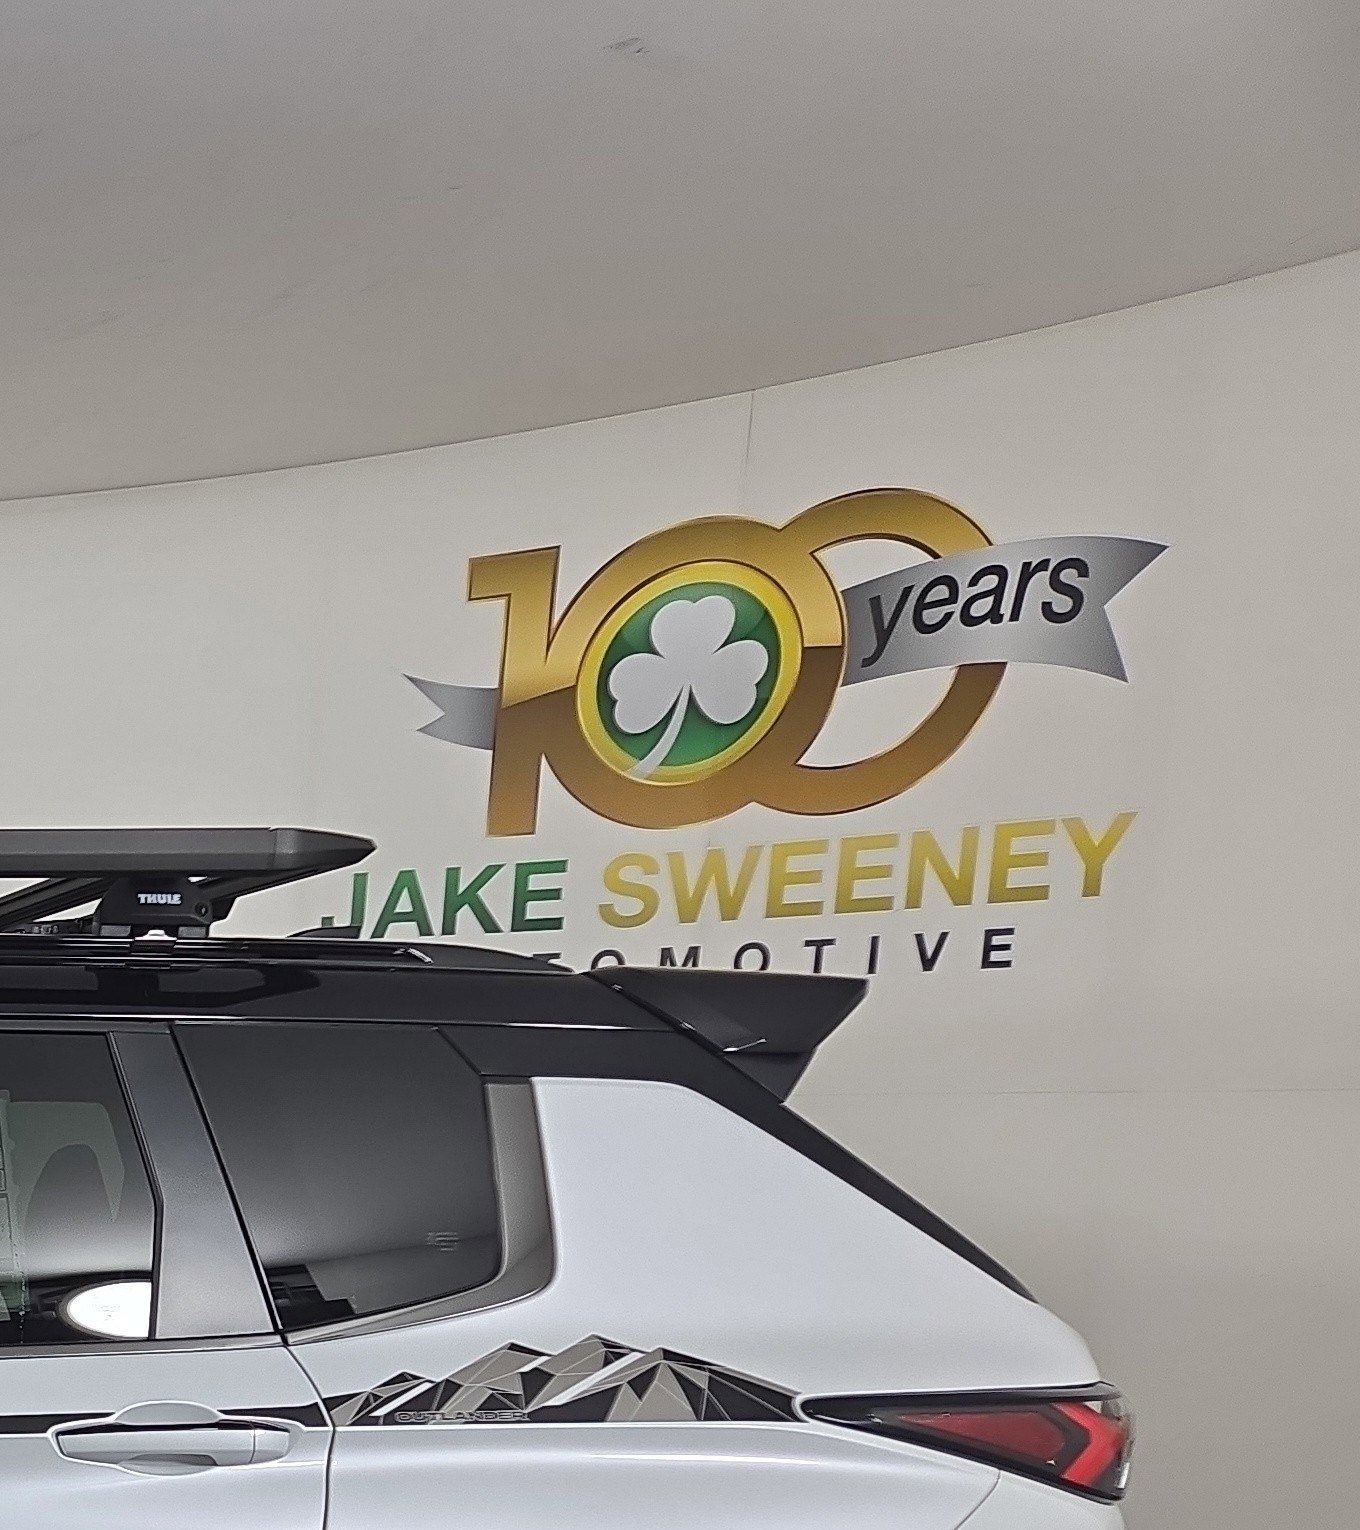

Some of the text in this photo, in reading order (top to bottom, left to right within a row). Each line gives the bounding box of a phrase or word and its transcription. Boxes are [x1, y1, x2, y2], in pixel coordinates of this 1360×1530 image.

[861, 555, 1089, 667] years
[137, 893, 182, 905] THULE
[320, 811, 1138, 939] JAKE SWEENEY
